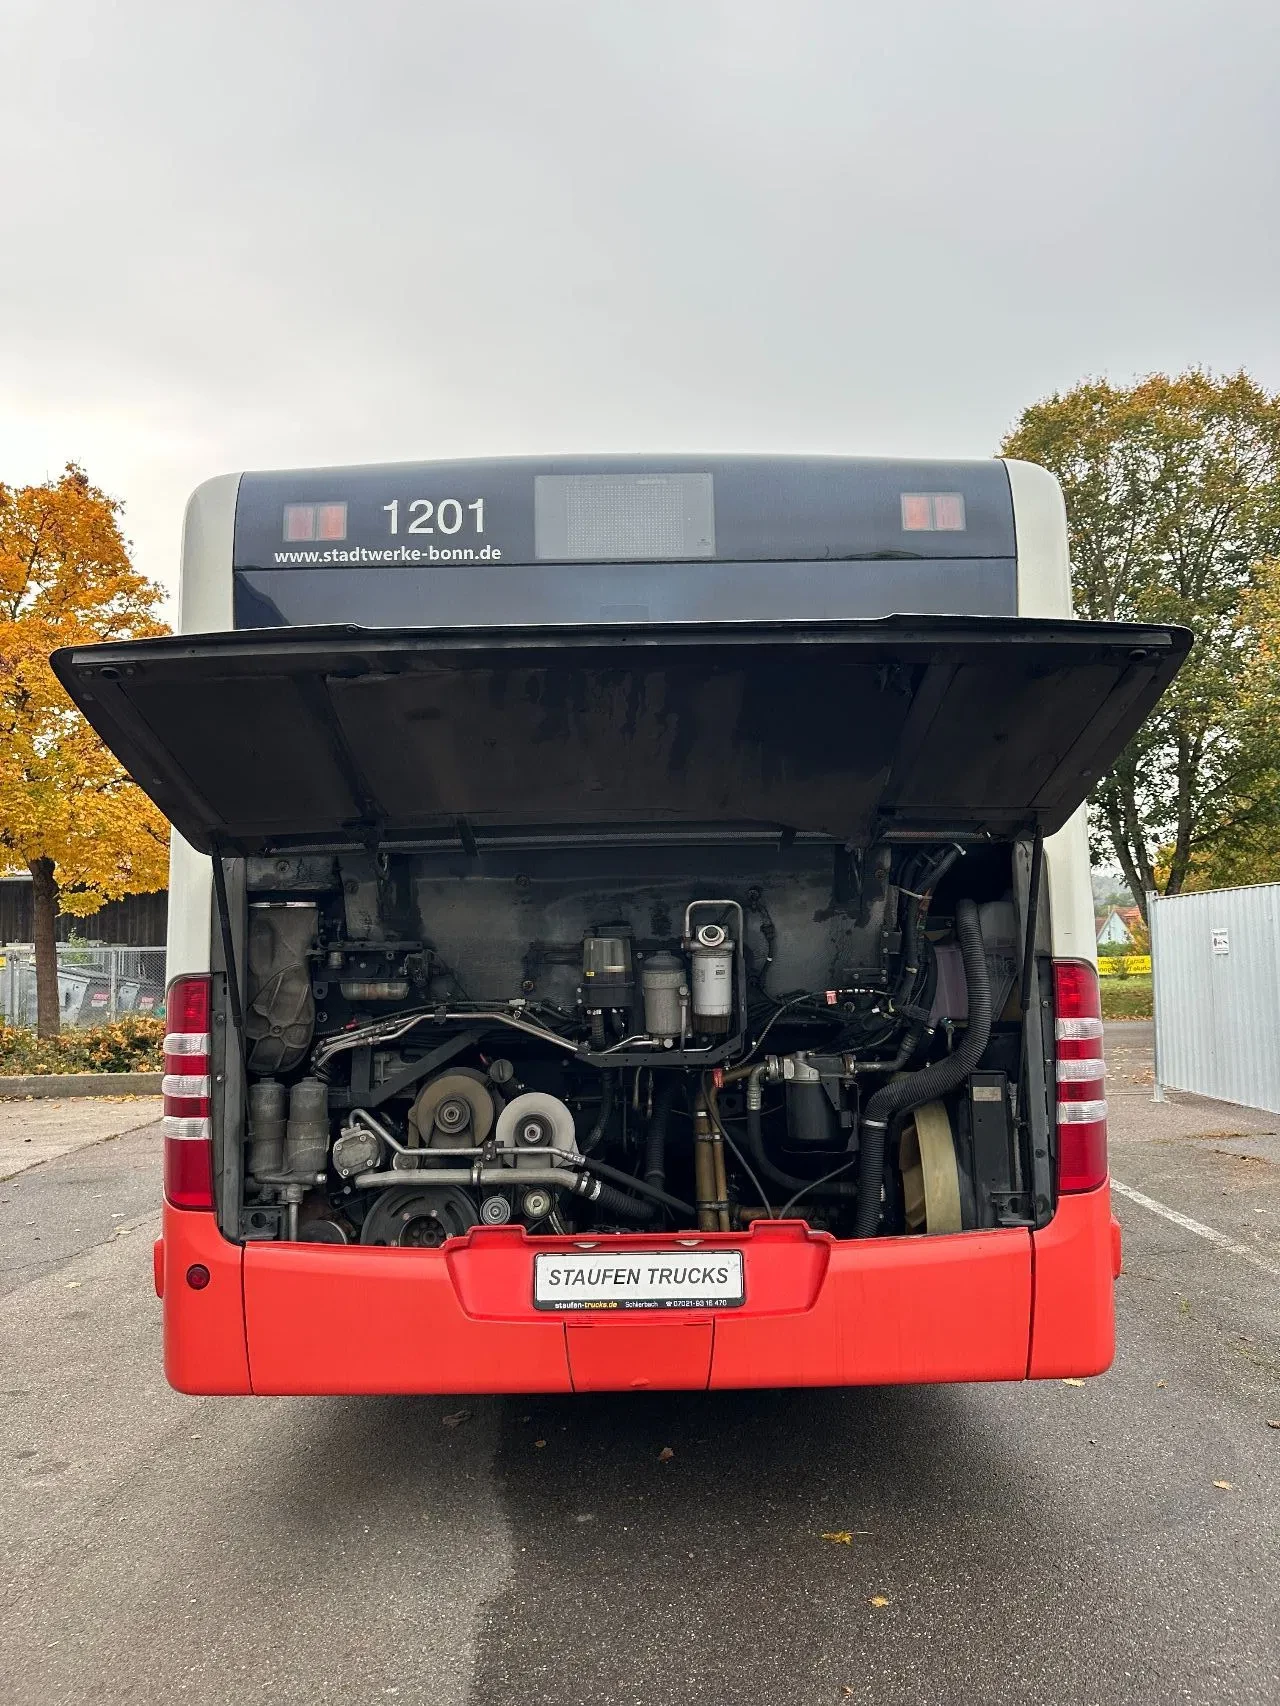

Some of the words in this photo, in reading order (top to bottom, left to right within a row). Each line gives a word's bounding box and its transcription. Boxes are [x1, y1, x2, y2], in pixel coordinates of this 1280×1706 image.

[383, 498, 484, 534] 1201
[274, 544, 502, 563] www.stadtwerke-bonn.de
[548, 1268, 641, 1286] STAUFEN
[647, 1267, 729, 1285] TRUCKS
[554, 1301, 618, 1309] staufen-trucks.de
